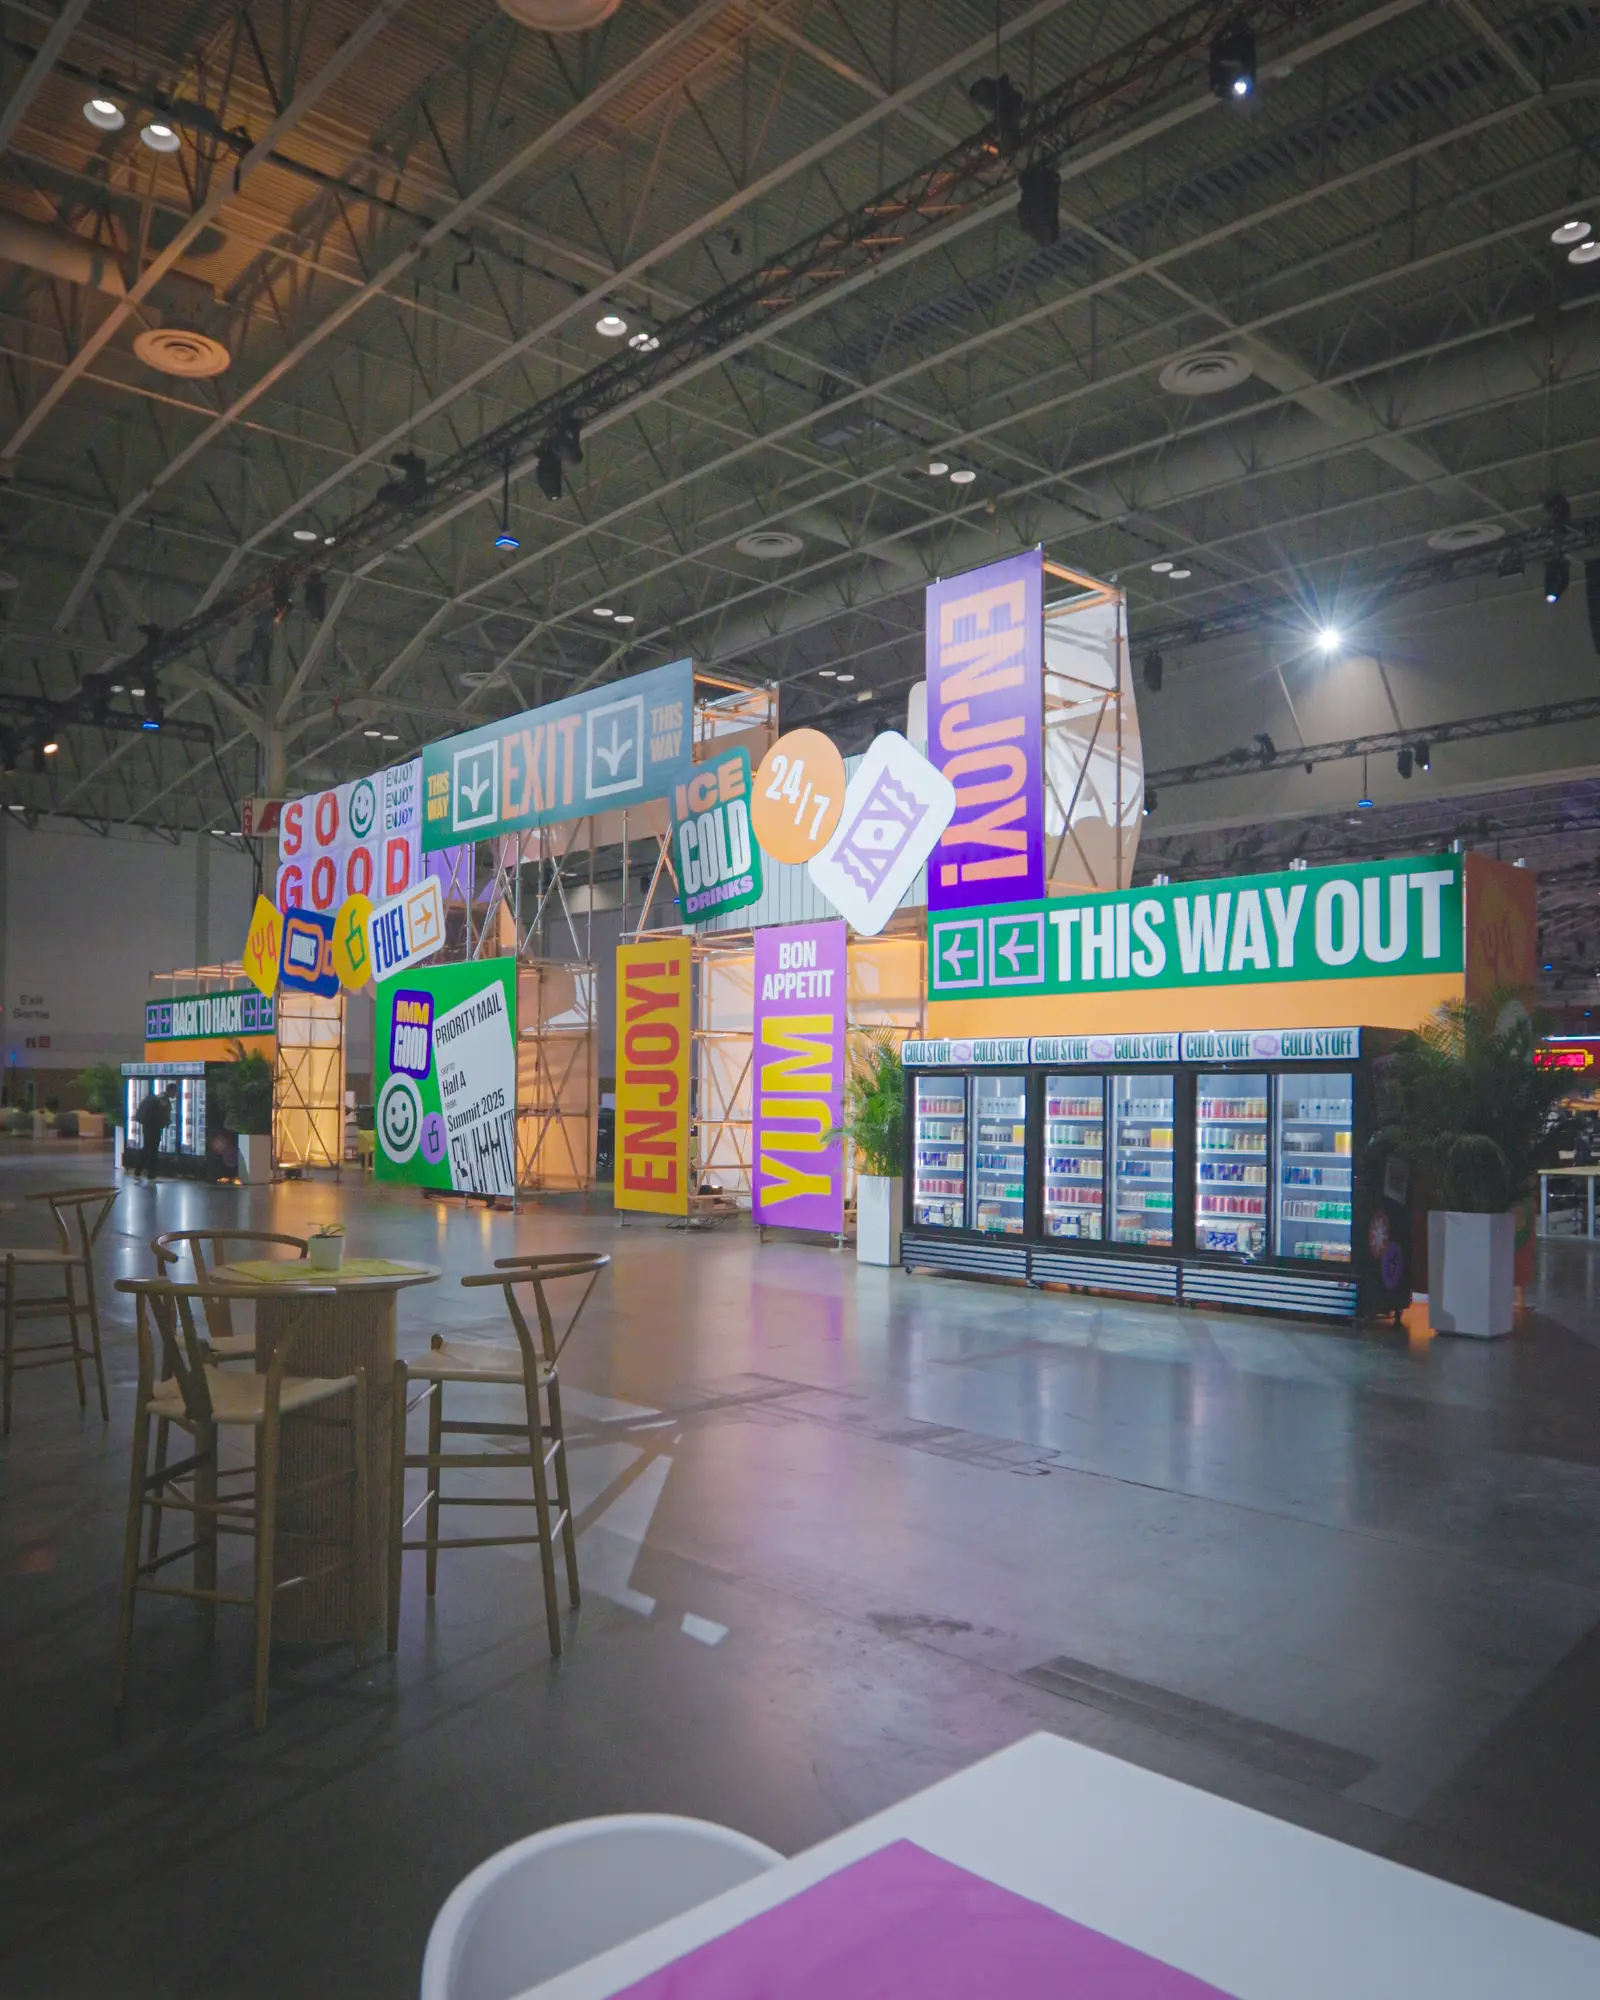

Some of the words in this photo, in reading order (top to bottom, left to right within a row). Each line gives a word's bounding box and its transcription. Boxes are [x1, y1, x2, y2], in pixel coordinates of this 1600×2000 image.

[650, 702, 683, 729] THIS
[940, 579, 1028, 887] ENJOY!
[650, 730, 682, 763] WAY
[386, 763, 414, 787] ENJOY
[428, 771, 449, 797] THIS
[501, 714, 582, 821] EXIT
[386, 785, 413, 808] ENJOY
[675, 757, 746, 820] ICE
[765, 755, 829, 841] 24/7
[283, 791, 339, 855] SO
[386, 806, 413, 830] ENJOY
[428, 795, 448, 822] WAY
[679, 799, 751, 895] COLD
[280, 837, 409, 916] GOOD
[687, 875, 753, 914] DRINKS
[372, 905, 409, 973] FUEL
[1049, 899, 1166, 983] THIS
[1174, 884, 1308, 975] WAY
[1314, 870, 1454, 967] OUT
[779, 940, 816, 969] BON
[762, 969, 834, 1001] APPETIT
[172, 1001, 198, 1036] BACK
[198, 999, 211, 1034] TO
[212, 996, 242, 1034] HACK
[435, 1006, 476, 1049] PRIORITY
[476, 992, 502, 1023] MAIL
[394, 1024, 428, 1071] GOOD
[904, 1041, 926, 1062] COLD
[927, 1041, 952, 1062] STUFF
[973, 1040, 996, 1062] COLD
[997, 1039, 1024, 1061] STUFF
[1035, 1038, 1059, 1061] COLD
[1060, 1037, 1089, 1060] STUFF
[1114, 1036, 1141, 1059] COLD
[1142, 1035, 1174, 1059] STUFF
[1186, 1035, 1215, 1058] COLD
[1217, 1034, 1250, 1058] STUFF
[1281, 1033, 1313, 1057] COLD
[1315, 1031, 1353, 1056] STUFF
[442, 1073, 459, 1098] Hall
[460, 1070, 467, 1089] A
[624, 959, 680, 1194] ENJOY!
[447, 1101, 481, 1132] Summit
[481, 1087, 505, 1116] 2025
[760, 1014, 834, 1207] YUM
